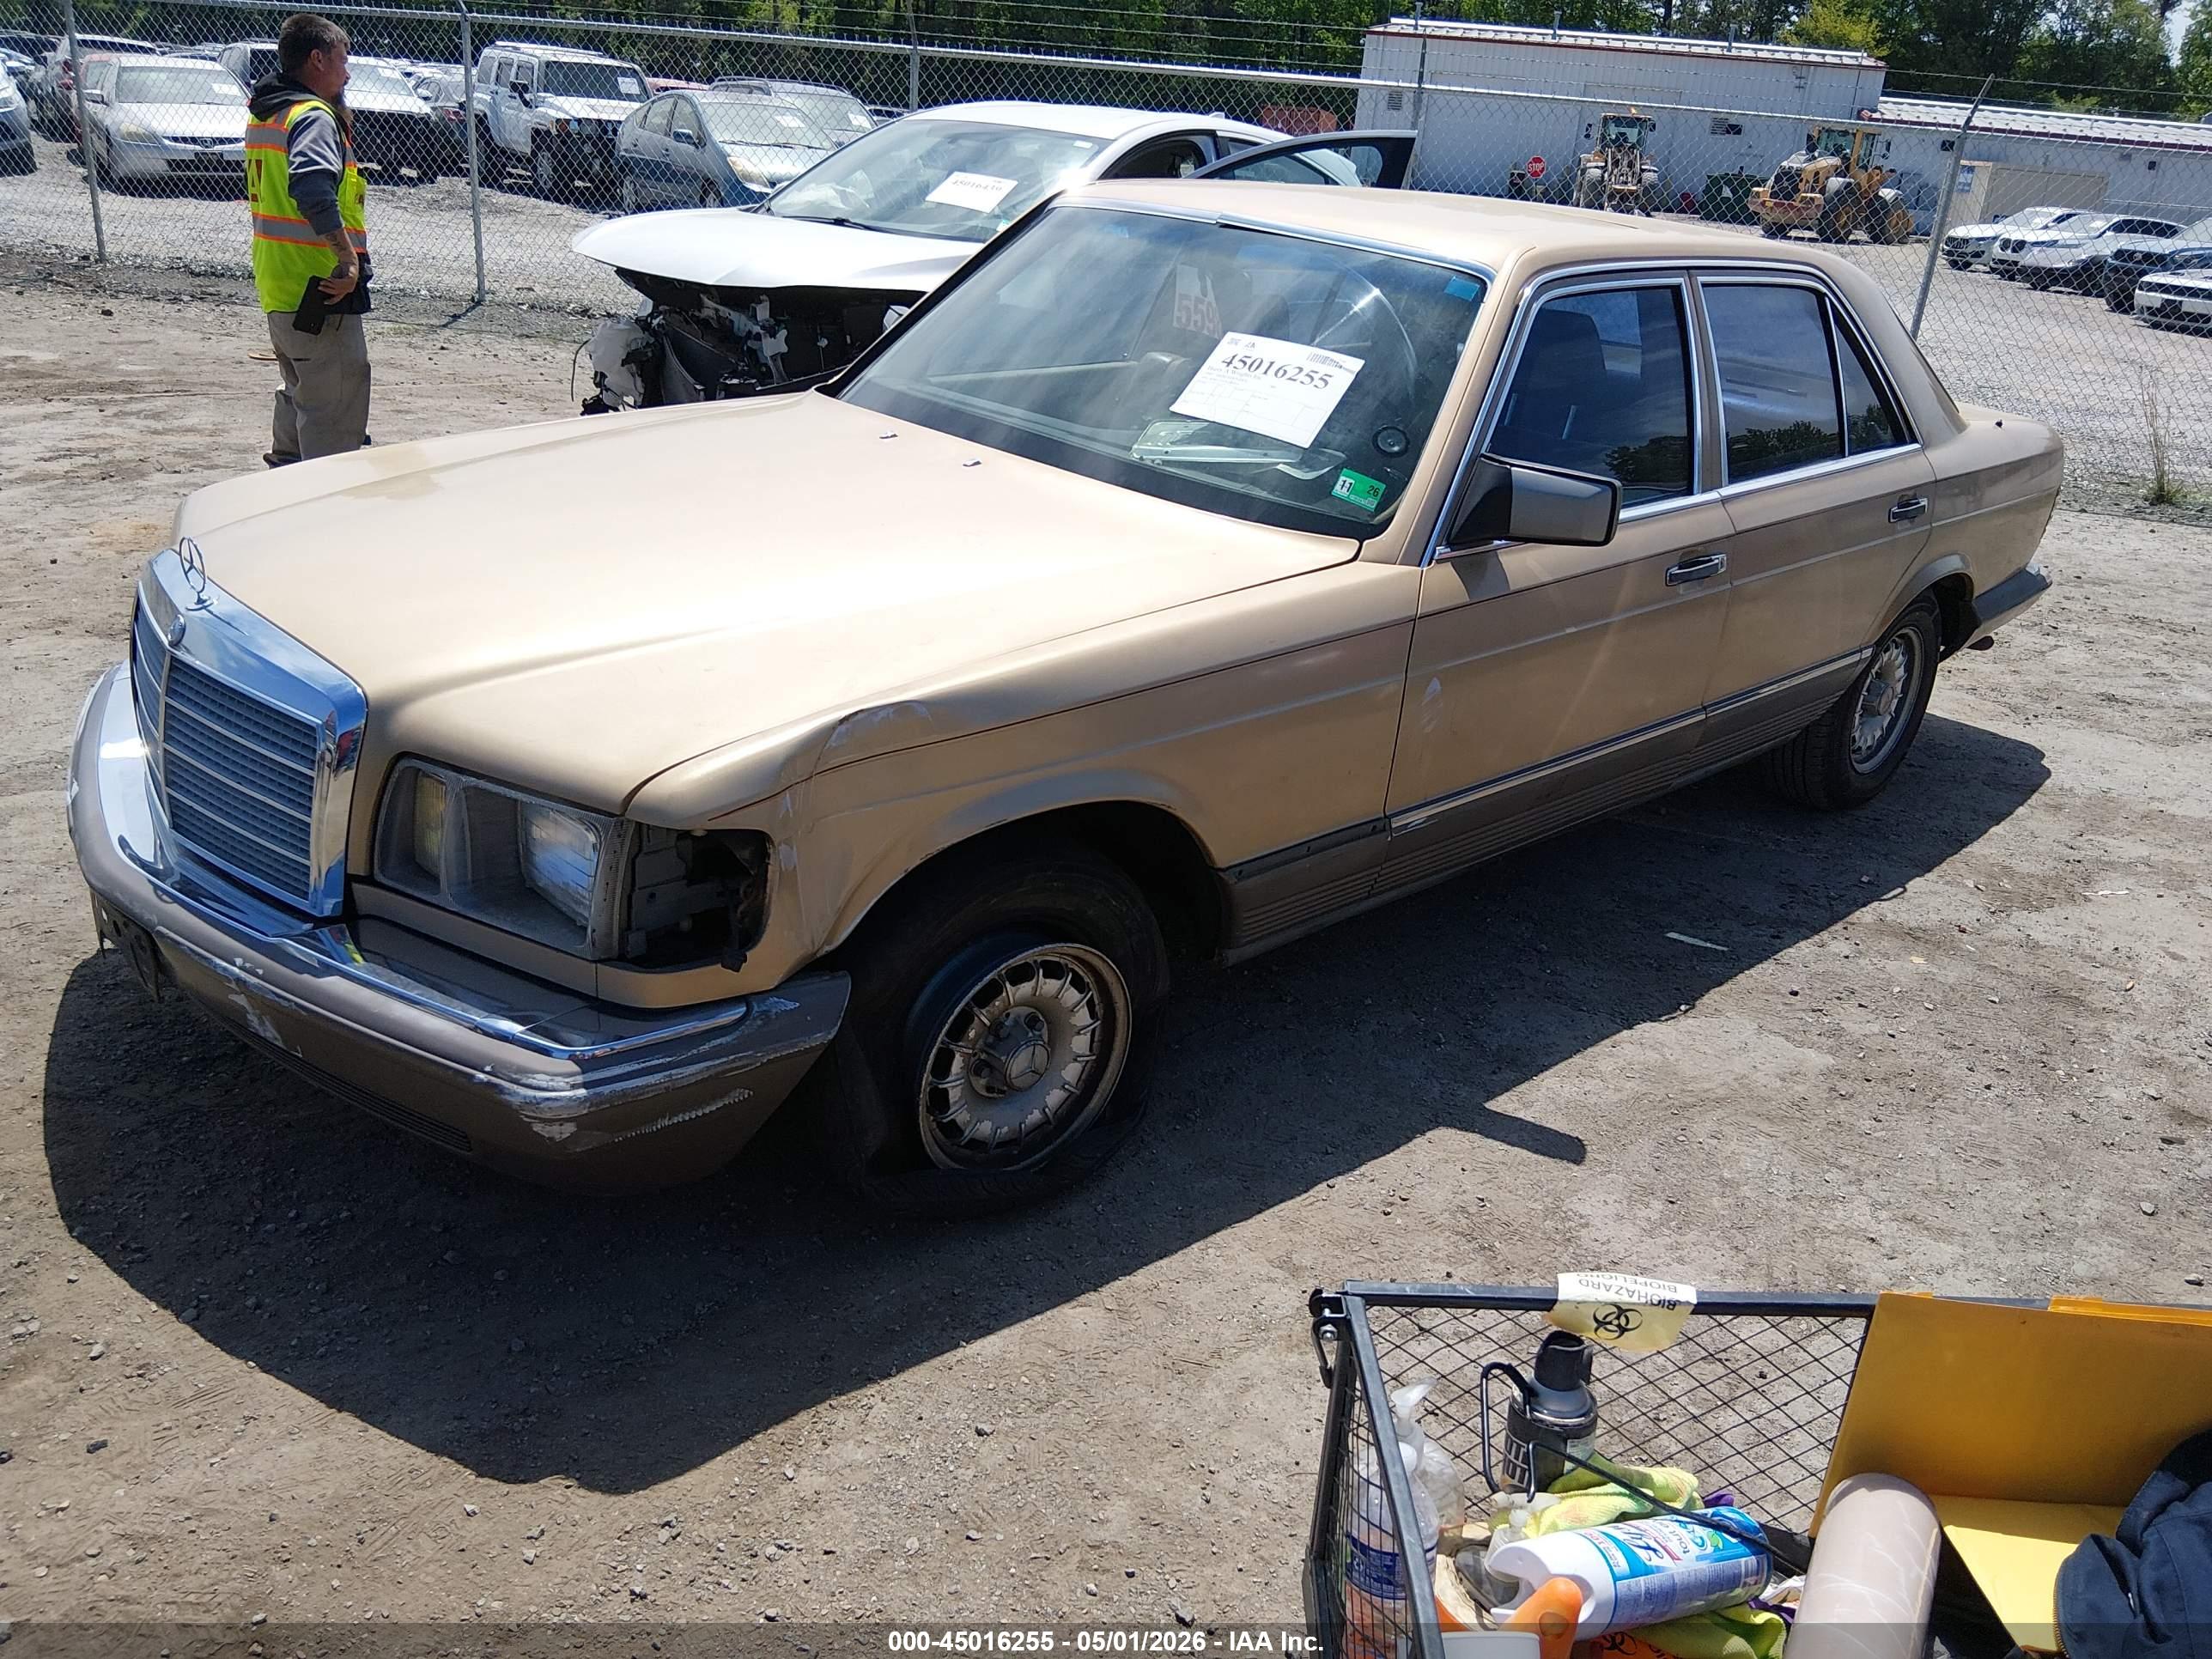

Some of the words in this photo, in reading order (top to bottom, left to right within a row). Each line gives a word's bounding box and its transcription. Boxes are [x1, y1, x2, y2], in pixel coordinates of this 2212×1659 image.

[1528, 162, 1544, 173] STOP
[1221, 353, 1334, 389] 45016255
[1340, 479, 1353, 493] 11
[1367, 484, 1381, 497] 26
[1578, 1278, 1678, 1311] BIOHAZARD
